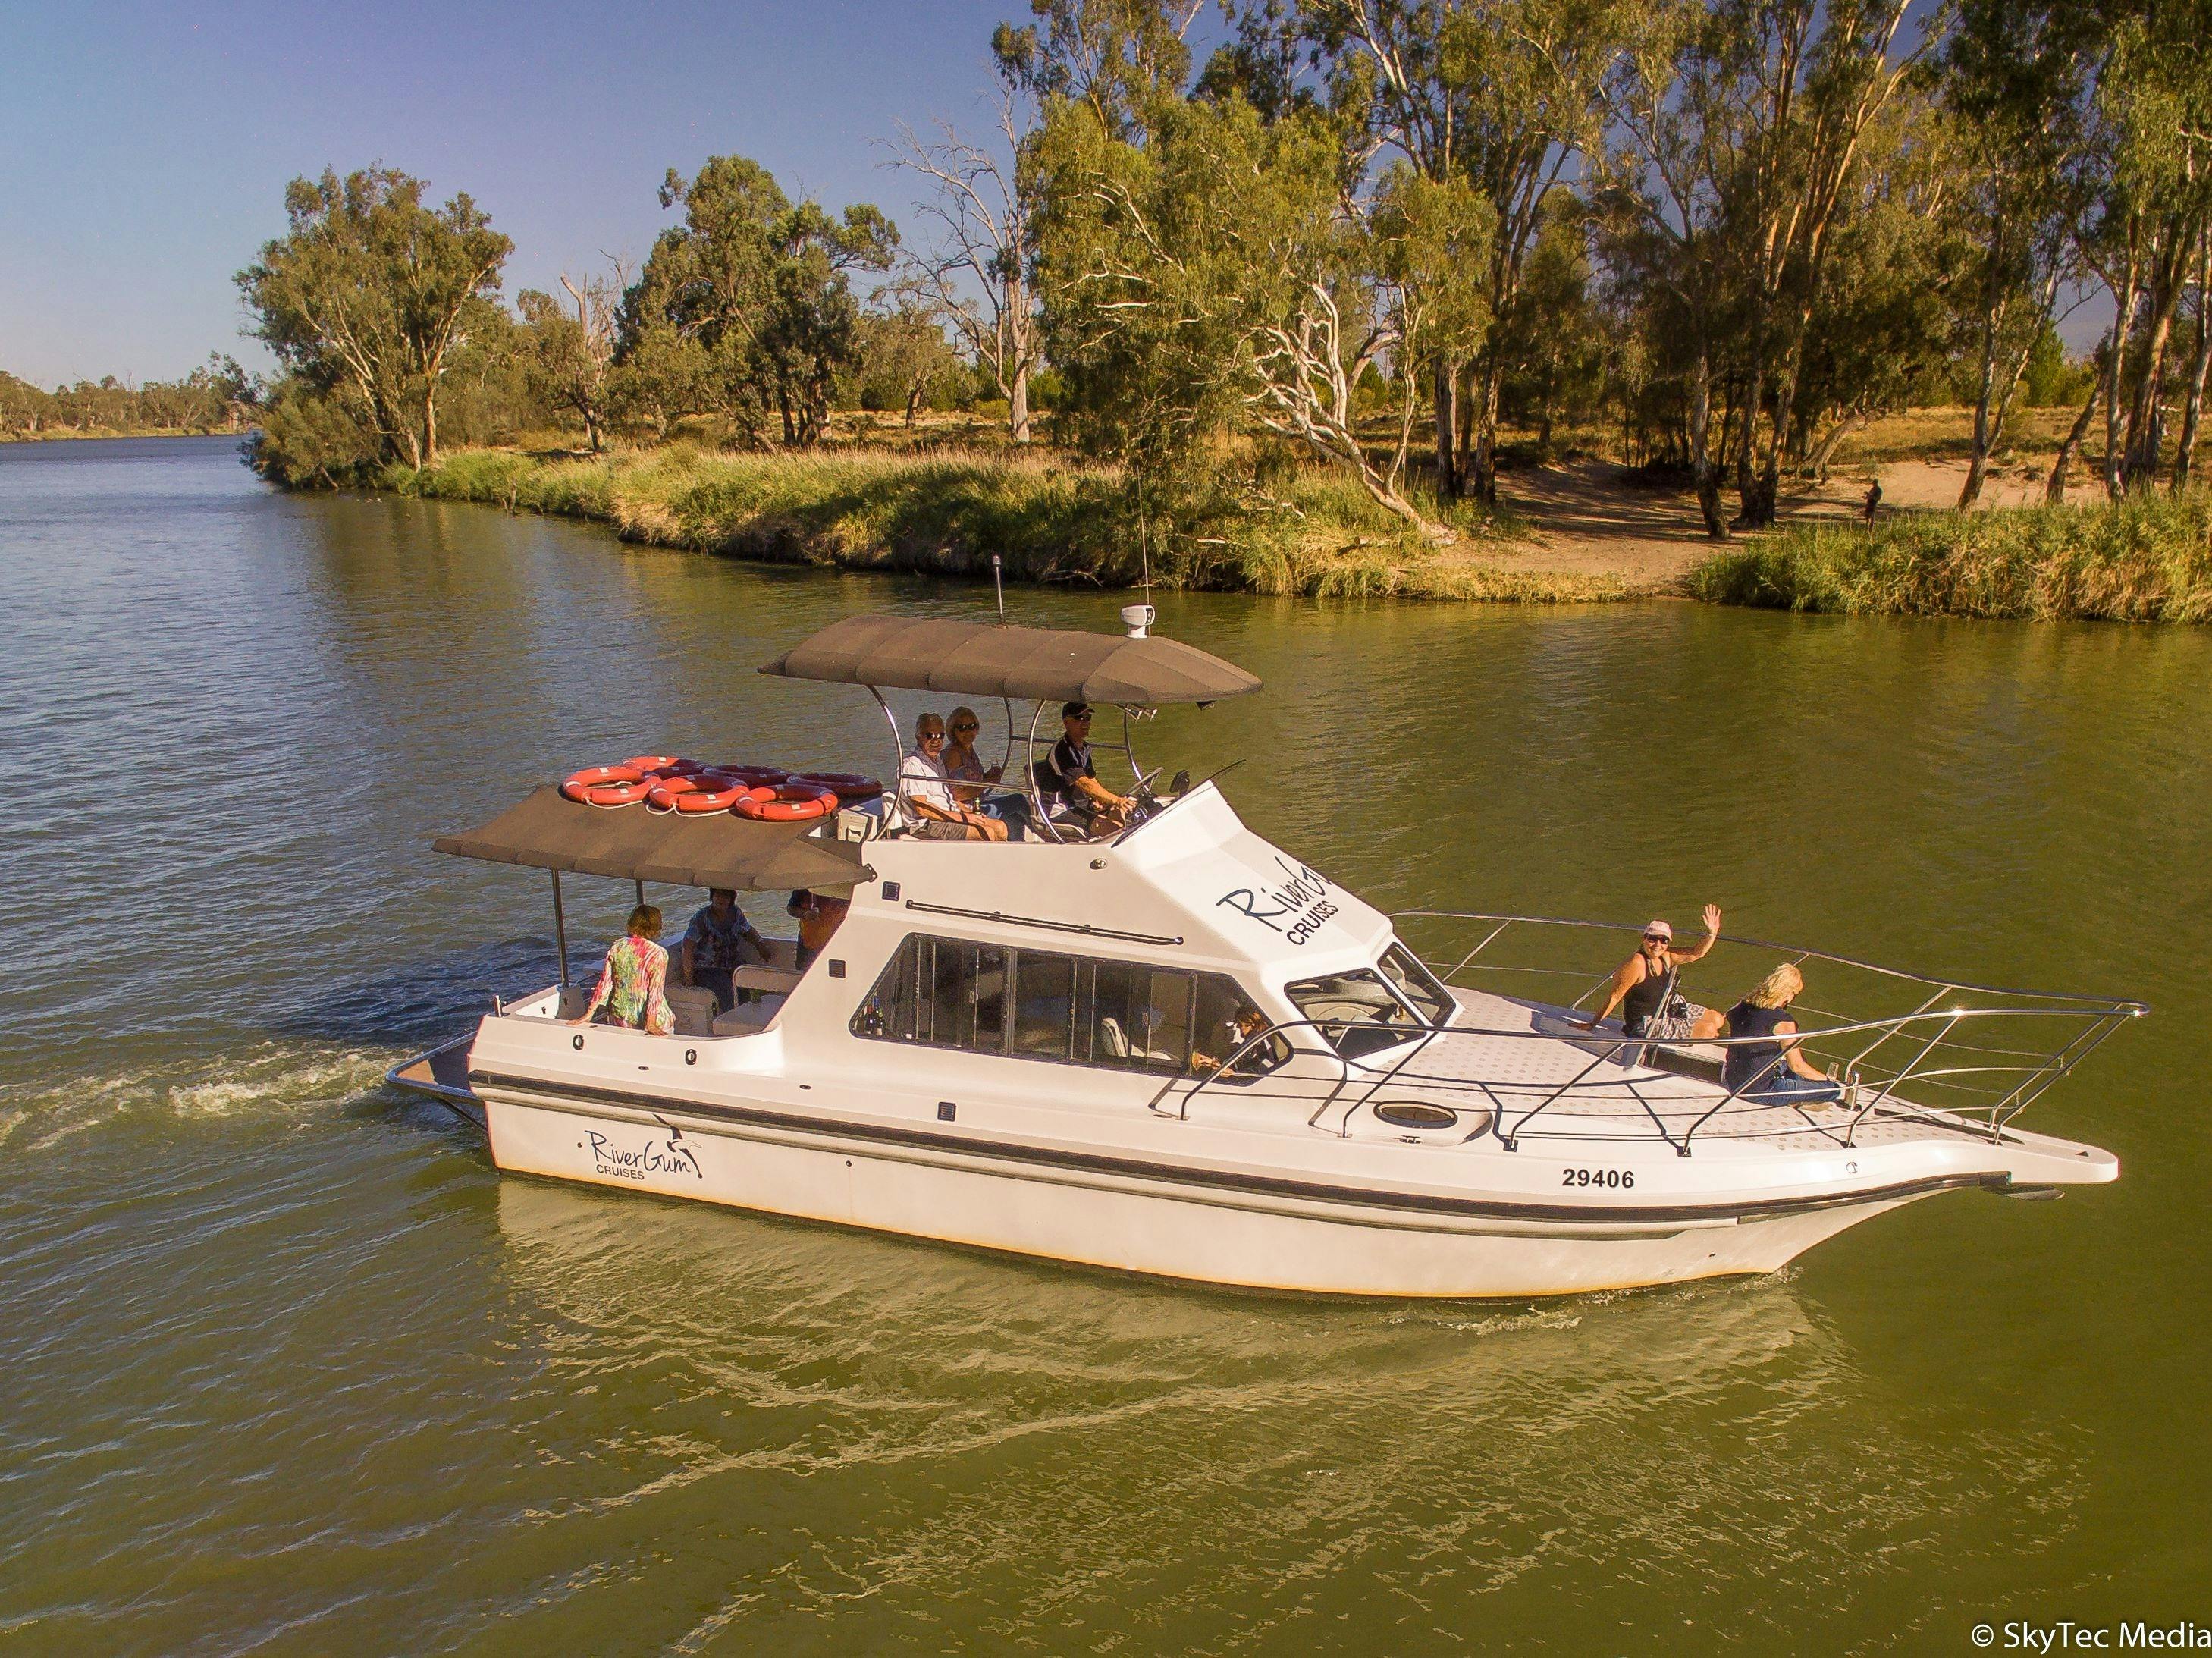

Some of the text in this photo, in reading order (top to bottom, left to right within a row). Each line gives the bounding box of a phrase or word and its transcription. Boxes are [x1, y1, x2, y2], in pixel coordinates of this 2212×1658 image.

[1287, 900, 1339, 945] CRUISES
[596, 1164, 645, 1180] CRUISES
[1562, 1169, 1634, 1189] 29406
